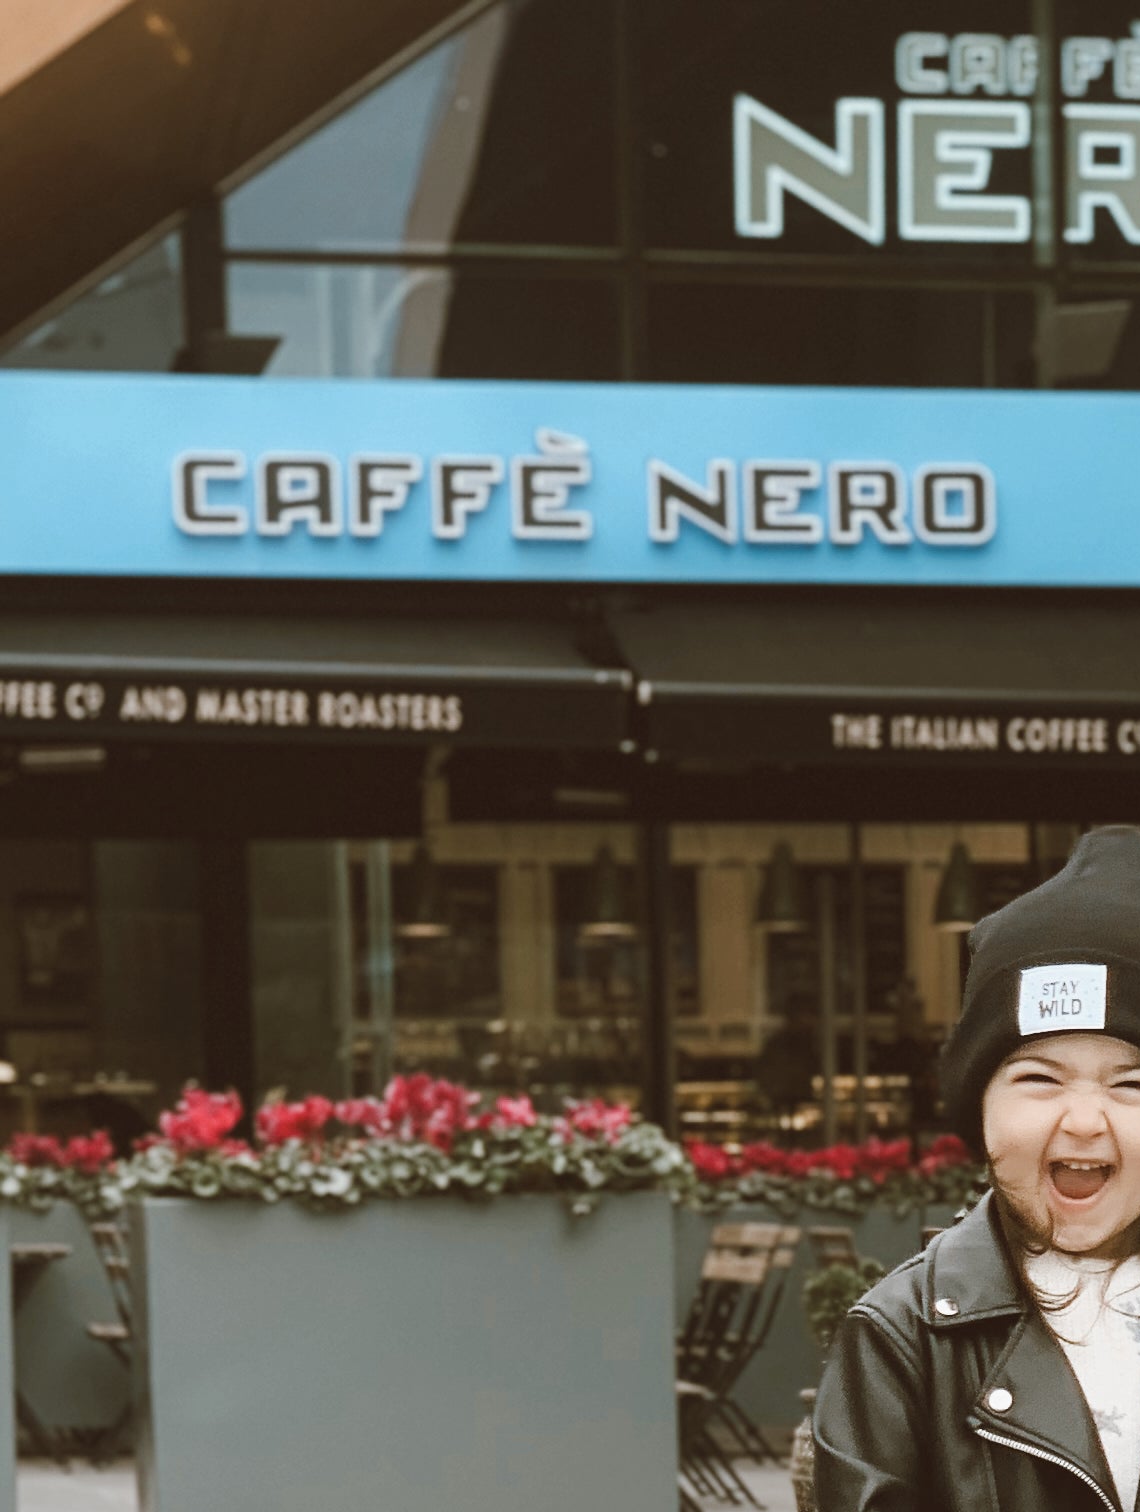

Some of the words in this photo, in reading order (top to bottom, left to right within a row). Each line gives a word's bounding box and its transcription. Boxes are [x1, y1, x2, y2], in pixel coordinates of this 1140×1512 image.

[172, 427, 593, 542] CAFFÈ
[647, 457, 997, 547] NERO
[120, 685, 187, 723] AND
[195, 689, 309, 726] MASTER
[317, 691, 463, 731] ROASTERS
[831, 713, 882, 750] THE
[890, 714, 999, 751] ITALIAN
[1006, 716, 1108, 753] COFFEE
[1039, 999, 1082, 1018] WILD
[1042, 981, 1081, 998] STAY
